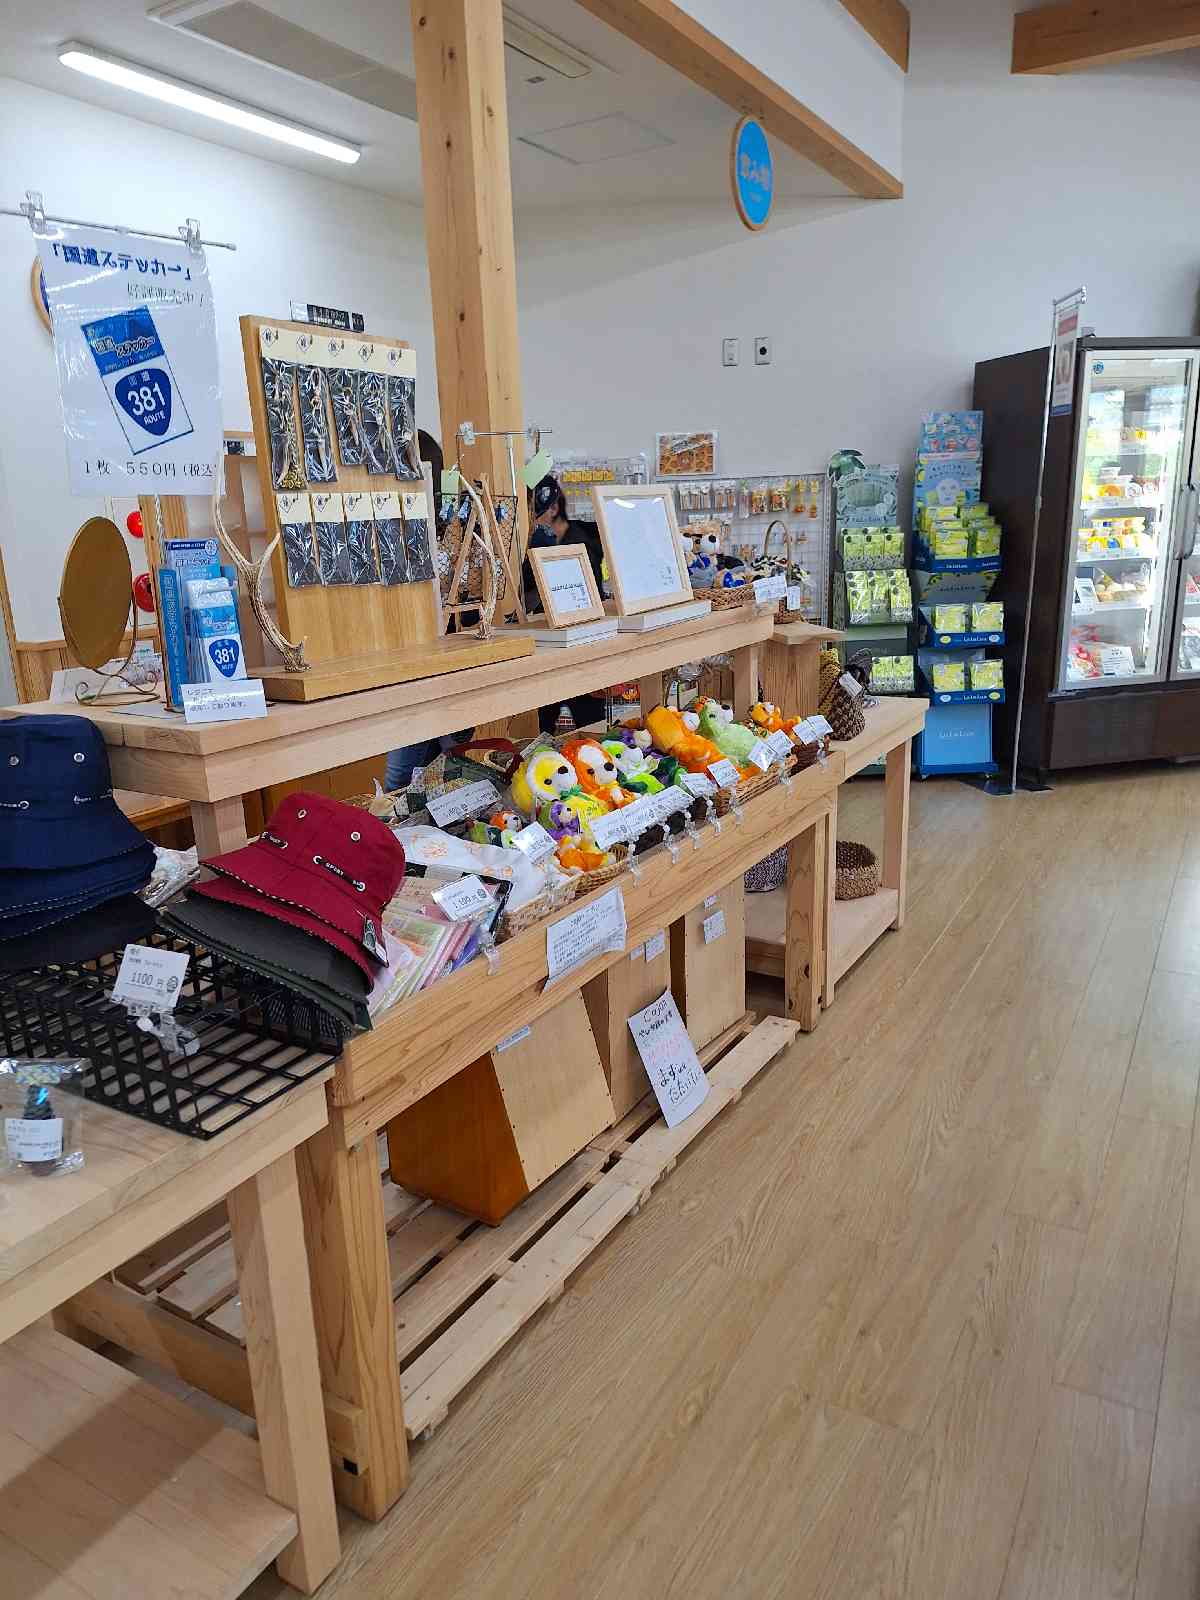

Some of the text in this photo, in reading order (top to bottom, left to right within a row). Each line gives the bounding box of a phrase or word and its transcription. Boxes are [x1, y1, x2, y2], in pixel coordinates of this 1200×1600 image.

[127, 382, 166, 416] 381
[143, 410, 166, 425] ROUTE
[215, 648, 236, 664] 381
[130, 970, 154, 987] 1100
